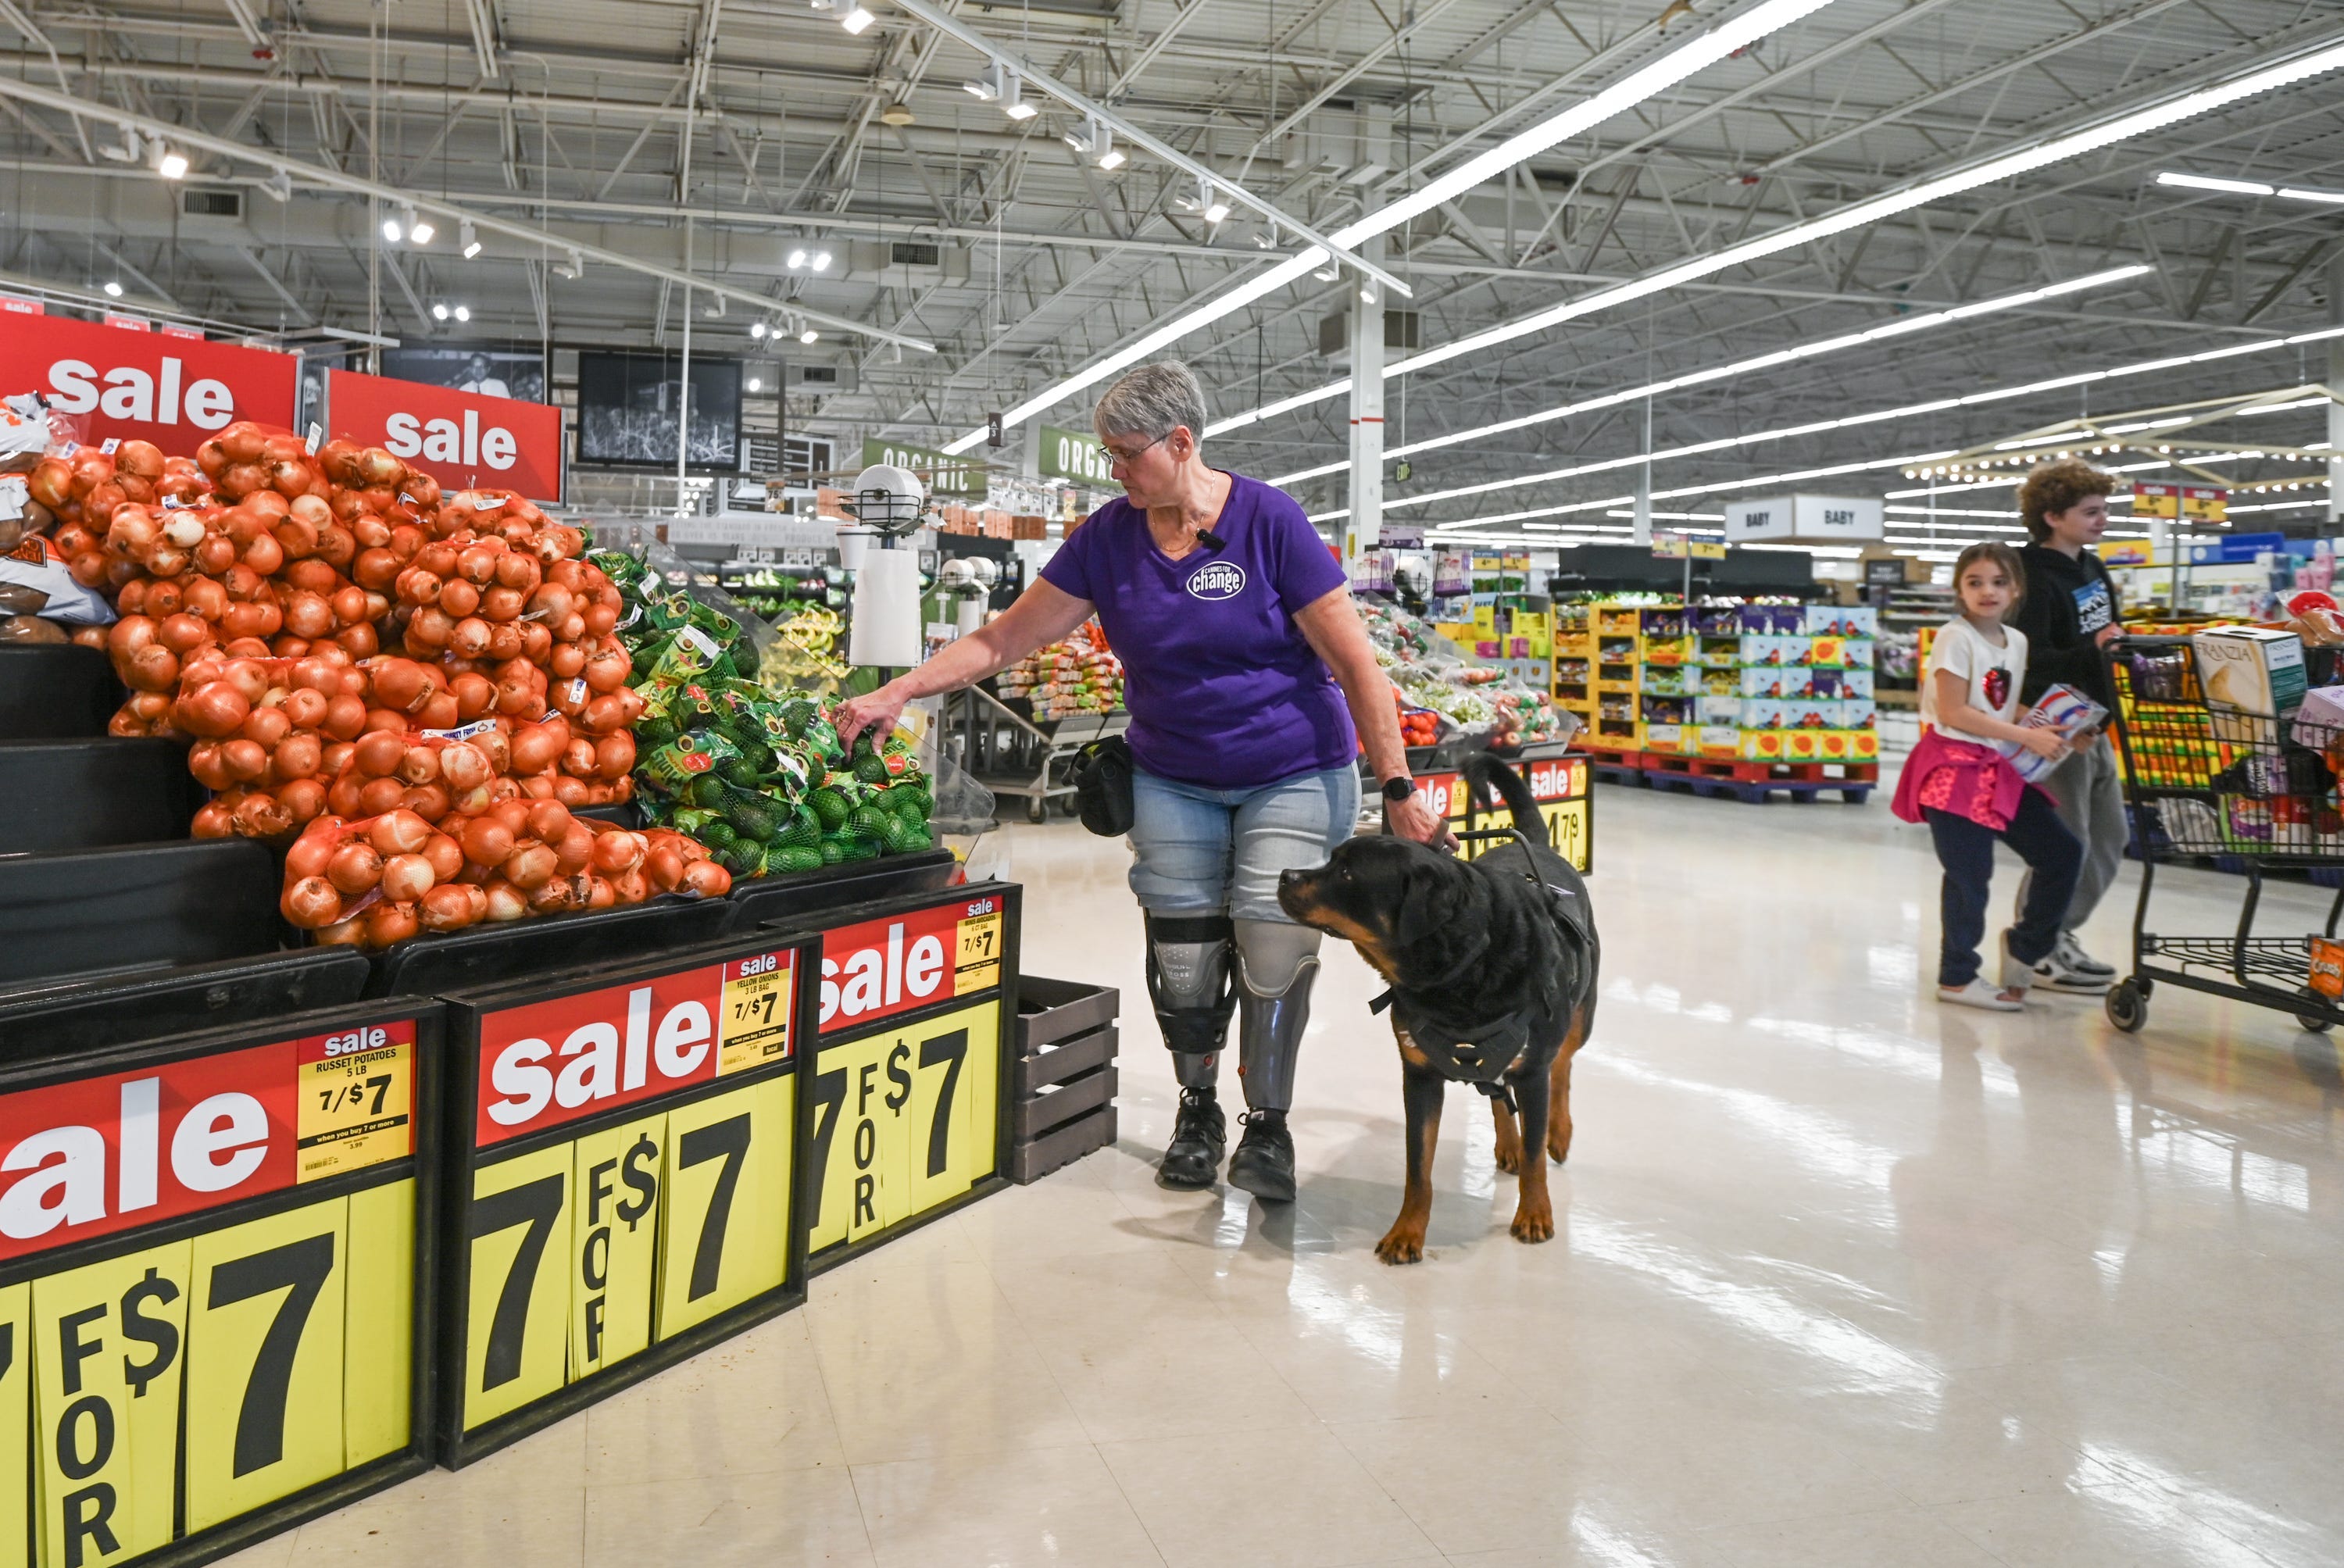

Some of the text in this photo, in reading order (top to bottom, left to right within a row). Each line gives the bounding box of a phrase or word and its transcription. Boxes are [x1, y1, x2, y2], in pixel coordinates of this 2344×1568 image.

[45, 357, 234, 430] sale
[384, 409, 516, 470] sale
[1059, 438, 1119, 481] ORGA
[1746, 512, 1771, 527] BABY
[1824, 510, 1855, 525] BABY
[1192, 568, 1240, 593] change
[1204, 566, 1223, 574] CANINES
[2197, 641, 2252, 662] FRANZIA
[1530, 763, 1568, 798] sale
[968, 898, 993, 917] sale
[965, 930, 994, 956] 7/$7
[741, 954, 777, 977] sale
[820, 923, 944, 1025] sale
[737, 973, 779, 988] YELLOW ONIONS
[759, 983, 770, 992] BAG
[735, 991, 777, 1024] 7/$7
[325, 1027, 386, 1056] sale
[766, 1044, 778, 1053] local
[316, 1048, 397, 1073] RUSSET POTATOES
[488, 987, 711, 1126] sale
[347, 1065, 367, 1077] 5 LB
[320, 1073, 392, 1116] 7/$7
[316, 1134, 335, 1143] when
[336, 1130, 348, 1140] you
[350, 1127, 362, 1137] buy
[377, 1120, 395, 1128] more
[0, 1077, 269, 1239] ale
[349, 1141, 363, 1150] 3.99
[854, 1062, 878, 1229] FOR
[471, 1172, 564, 1393] 7
[57, 1302, 121, 1568] FOR
